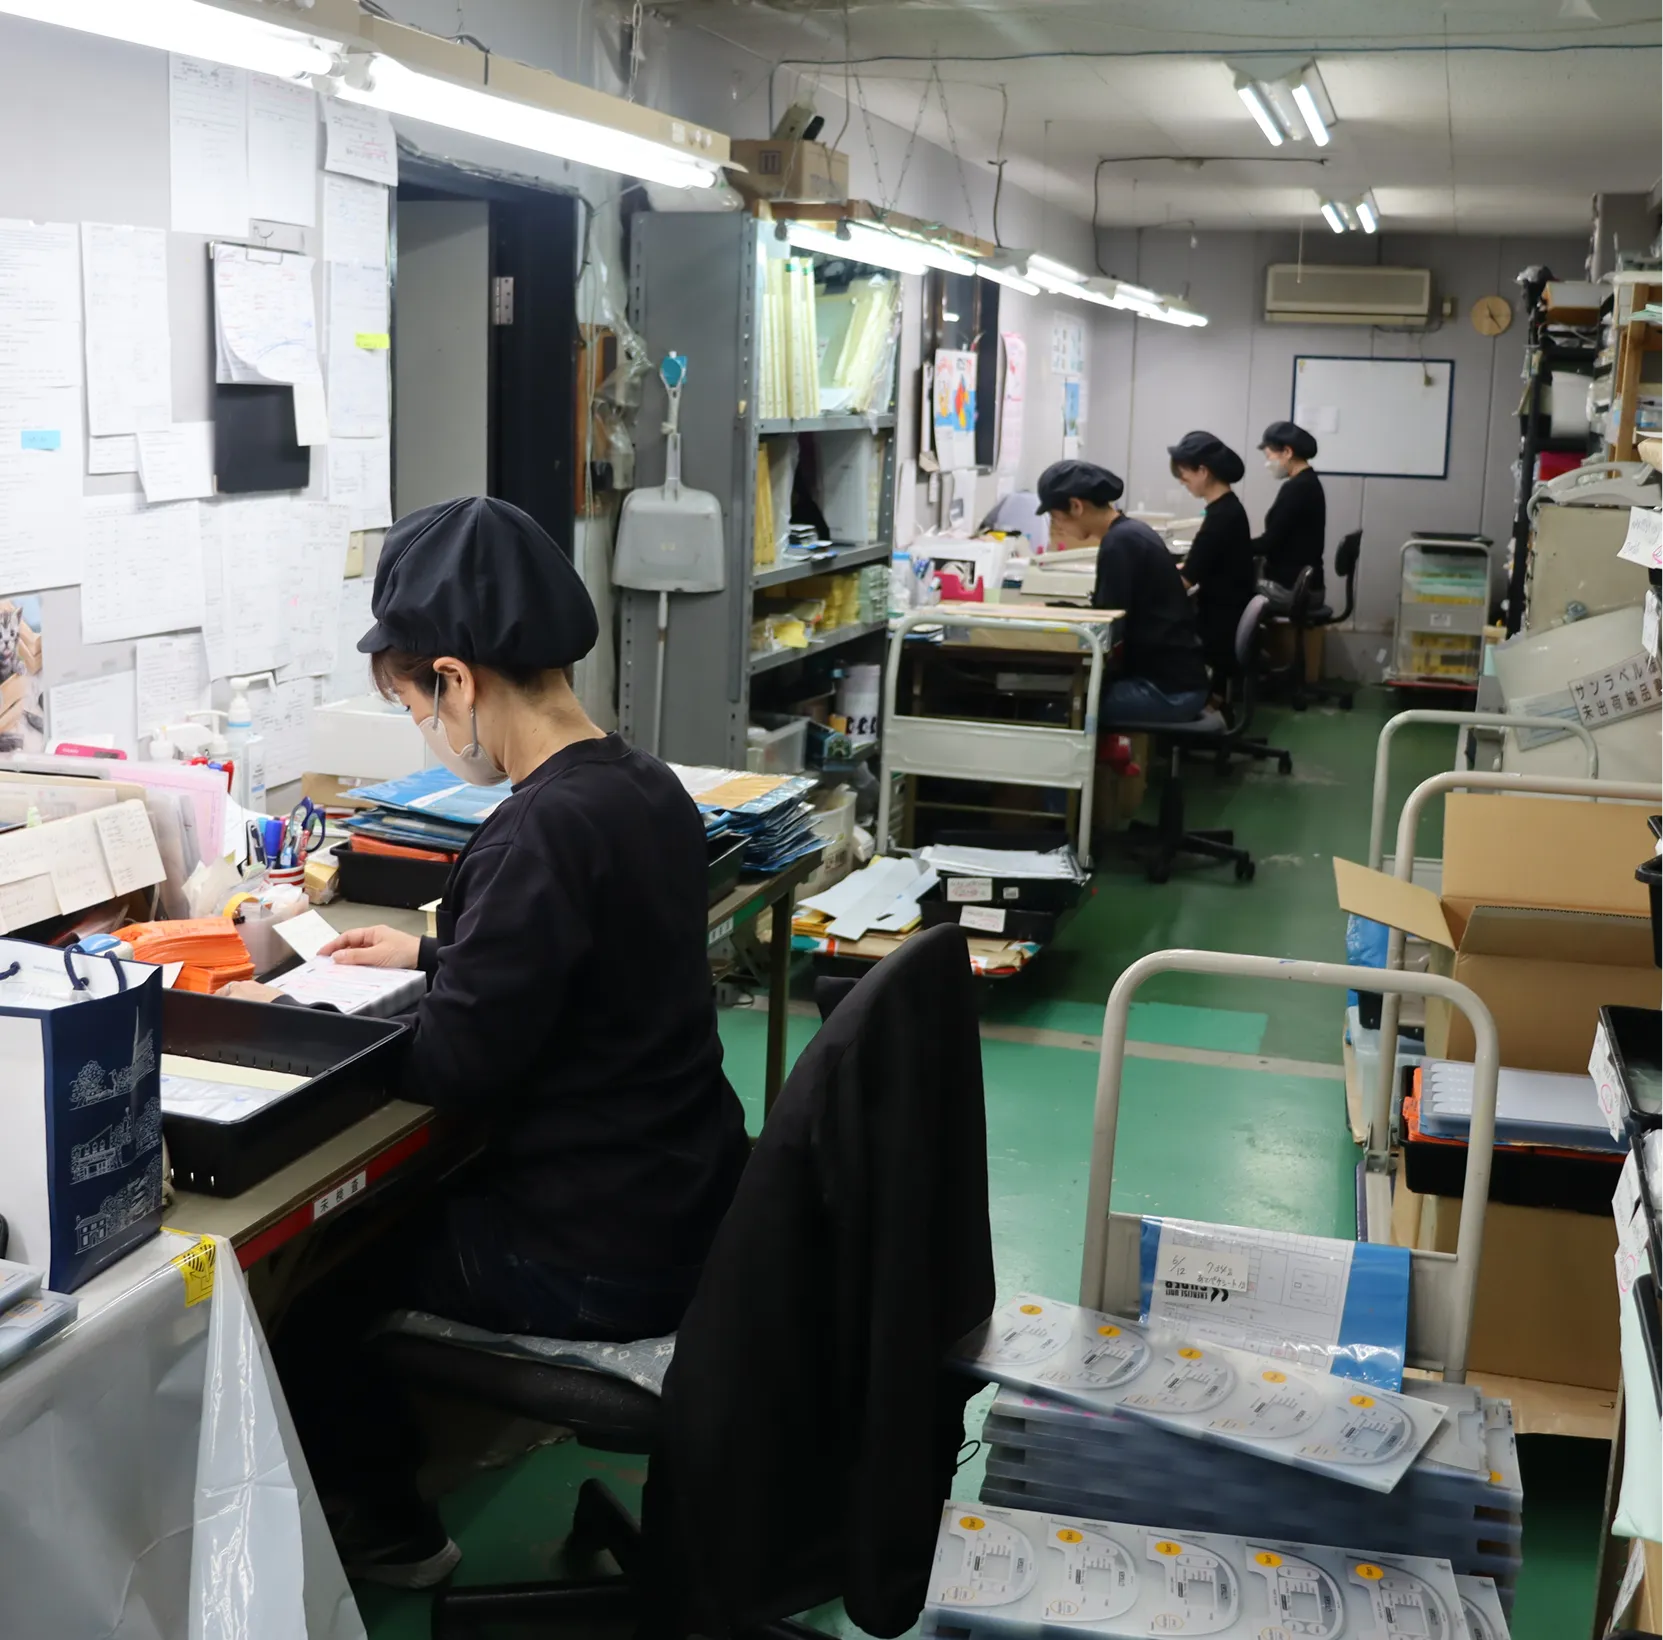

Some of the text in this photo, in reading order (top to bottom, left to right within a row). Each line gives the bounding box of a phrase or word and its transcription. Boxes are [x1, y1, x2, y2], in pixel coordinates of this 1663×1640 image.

[320, 1178, 359, 1213] 未検査
[1169, 1254, 1186, 1276] 6/12
